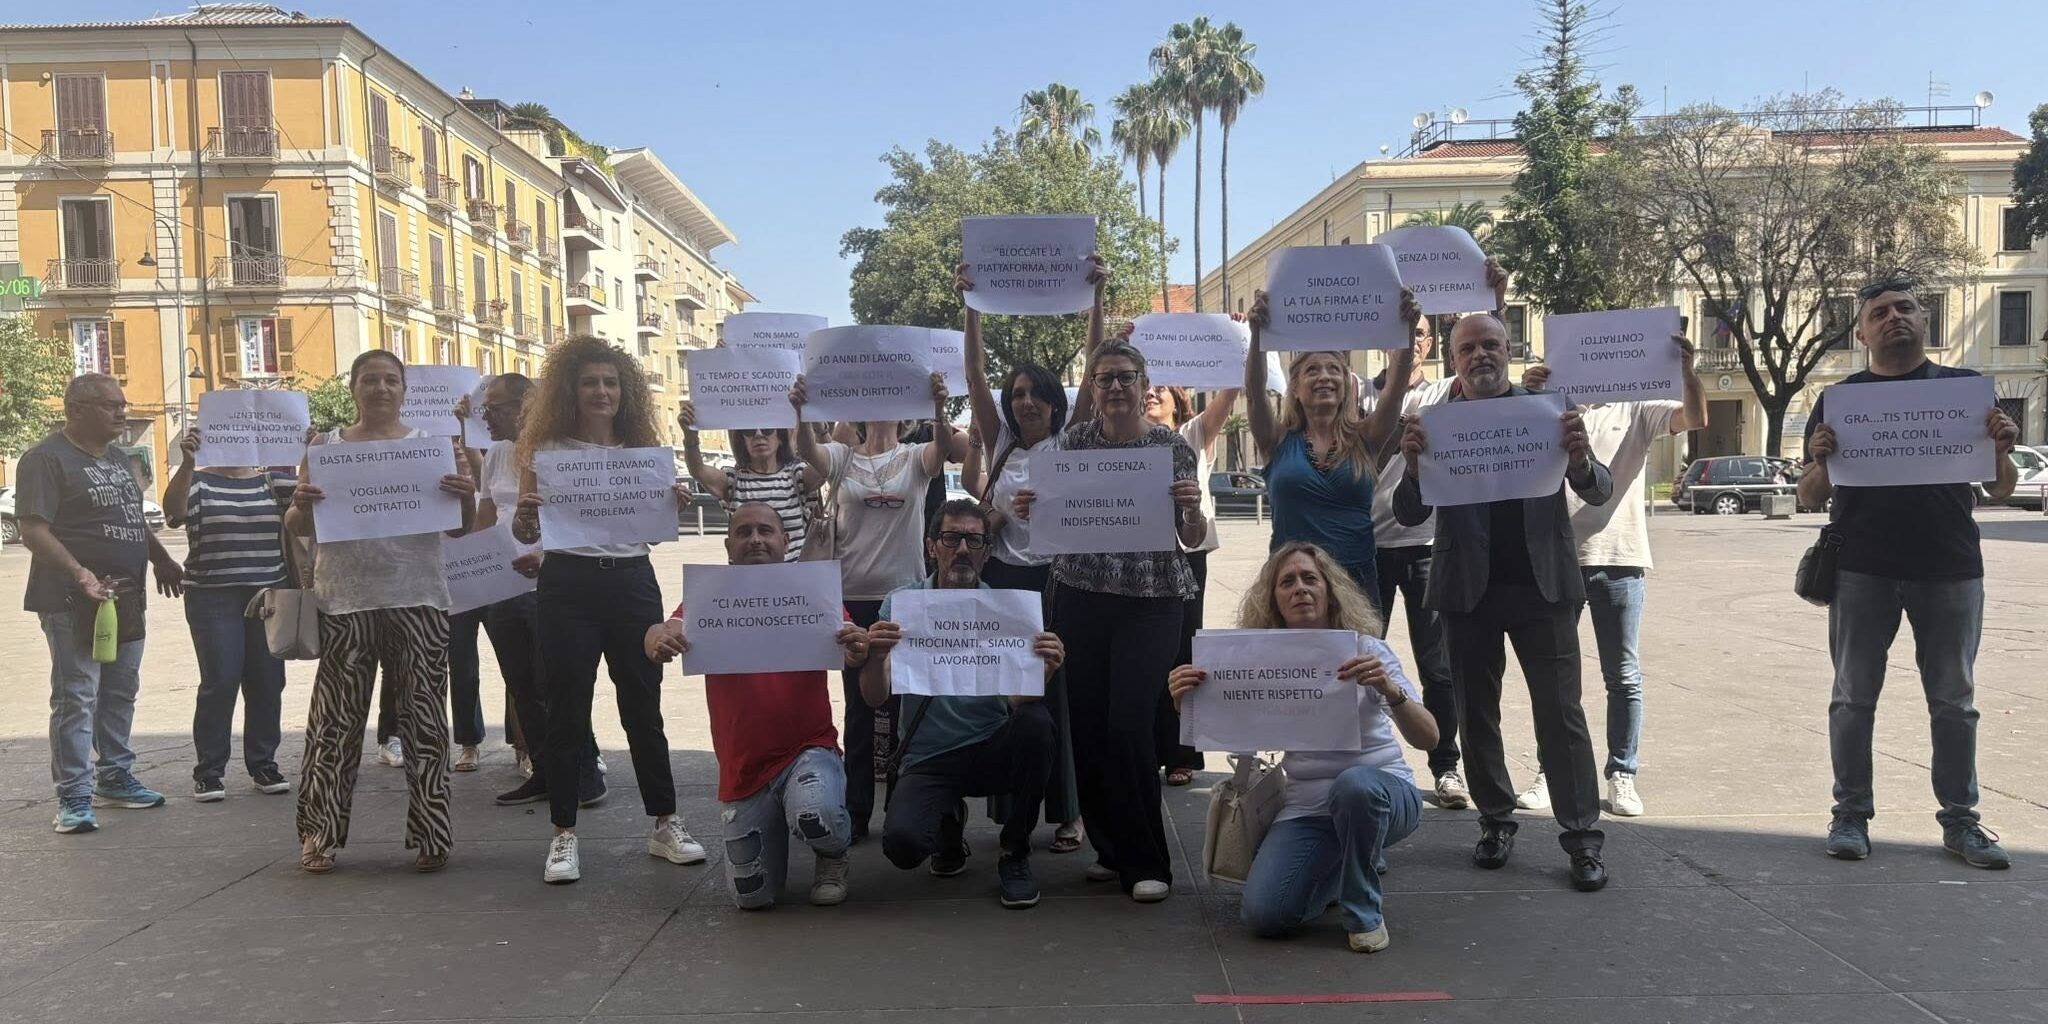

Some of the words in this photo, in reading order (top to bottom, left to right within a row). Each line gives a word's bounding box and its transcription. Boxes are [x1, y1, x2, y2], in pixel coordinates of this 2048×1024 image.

[1050, 247, 1061, 257] LA
[1399, 253, 1428, 263] SENZA
[1430, 252, 1439, 261] DI
[977, 263, 1048, 274] PIATTAFORMA,
[1050, 263, 1073, 272] NON
[990, 279, 1025, 288] NOSTRI
[1307, 276, 1360, 288] SINDACO!
[1429, 284, 1437, 293] SI
[1439, 282, 1475, 292] FERMA!
[1283, 297, 1296, 307] LA
[1300, 296, 1322, 306] TUA
[1324, 295, 1359, 305] FIRMA
[1375, 294, 1384, 304] IL
[1287, 312, 1332, 324] NOSTRO
[1334, 311, 1380, 322] FUTURO
[753, 331, 771, 339] NON
[773, 331, 799, 339] SIAMO
[1156, 333, 1177, 341] ANNI
[1179, 334, 1188, 342] DI
[1581, 333, 1644, 345] CONTRATTO!
[832, 354, 857, 363] ANNI
[860, 353, 870, 363] DI
[873, 353, 915, 363] LAVORO,
[1579, 352, 1588, 362] IL
[1590, 349, 1646, 361] VOGLIAMO
[1166, 359, 1173, 367] IL
[709, 371, 740, 380] TEMPO
[410, 385, 449, 393] SINDACO!
[700, 385, 719, 393] ORA
[721, 384, 769, 393] CONTRATTI
[771, 384, 790, 392] NON
[1640, 379, 1671, 390] BASTA
[820, 388, 859, 398] NESSUN
[406, 398, 422, 406] TUA
[424, 397, 450, 405] FIRMA
[721, 398, 736, 406] PIU
[433, 408, 456, 417] FUTU
[1904, 410, 1944, 422] TUTTO
[1948, 409, 1969, 420] OK.
[209, 424, 230, 432] NON
[232, 424, 281, 432] CONTRATTI
[283, 424, 302, 432] ORA
[1516, 427, 1529, 438] LA
[1872, 430, 1898, 441] ORA
[1902, 429, 1929, 440] CON
[1932, 430, 1943, 439] IL
[319, 454, 353, 465] BASTA
[355, 448, 444, 463] SFRUTTAMENTO:
[1433, 445, 1514, 461] PIATTAFORMA,
[1517, 442, 1543, 453] NON
[1842, 446, 1915, 459] CONTRATTO
[1918, 444, 1974, 456] SILENZIO
[556, 461, 603, 472] GRATUITI
[606, 459, 656, 470] ERAVAMO
[1055, 462, 1070, 473] TIS
[1078, 462, 1089, 471] DI
[1450, 464, 1489, 476] NOSTRI
[573, 478, 600, 488] UTILI.
[609, 476, 631, 486] CON
[633, 476, 642, 485] IL
[350, 484, 409, 497] VOGLIAMO
[412, 484, 421, 493] IL
[549, 492, 611, 503] CONTRATTO
[613, 490, 647, 501] SIAMO
[650, 490, 665, 499] UN
[353, 500, 421, 514] CONTRATTO!
[1065, 498, 1114, 508] INVISIBILI
[1117, 498, 1135, 508] MA
[580, 506, 636, 517] PROBLEMA
[1061, 516, 1141, 527] INDISPENSABILI
[733, 597, 769, 609] AVETE
[772, 595, 809, 608] USATI,
[698, 618, 723, 629] ORA
[934, 620, 960, 631] NON
[963, 620, 1000, 631] SIAMO
[908, 638, 982, 648] TIROCINANTI.
[988, 638, 1025, 649] SIAMO
[933, 655, 1001, 665] LAVORATORI
[1213, 669, 1254, 681] NIENTE
[1258, 668, 1318, 680] ADESIONE
[1223, 689, 1264, 700] NIENTE
[1268, 688, 1323, 700] RISPETTO
